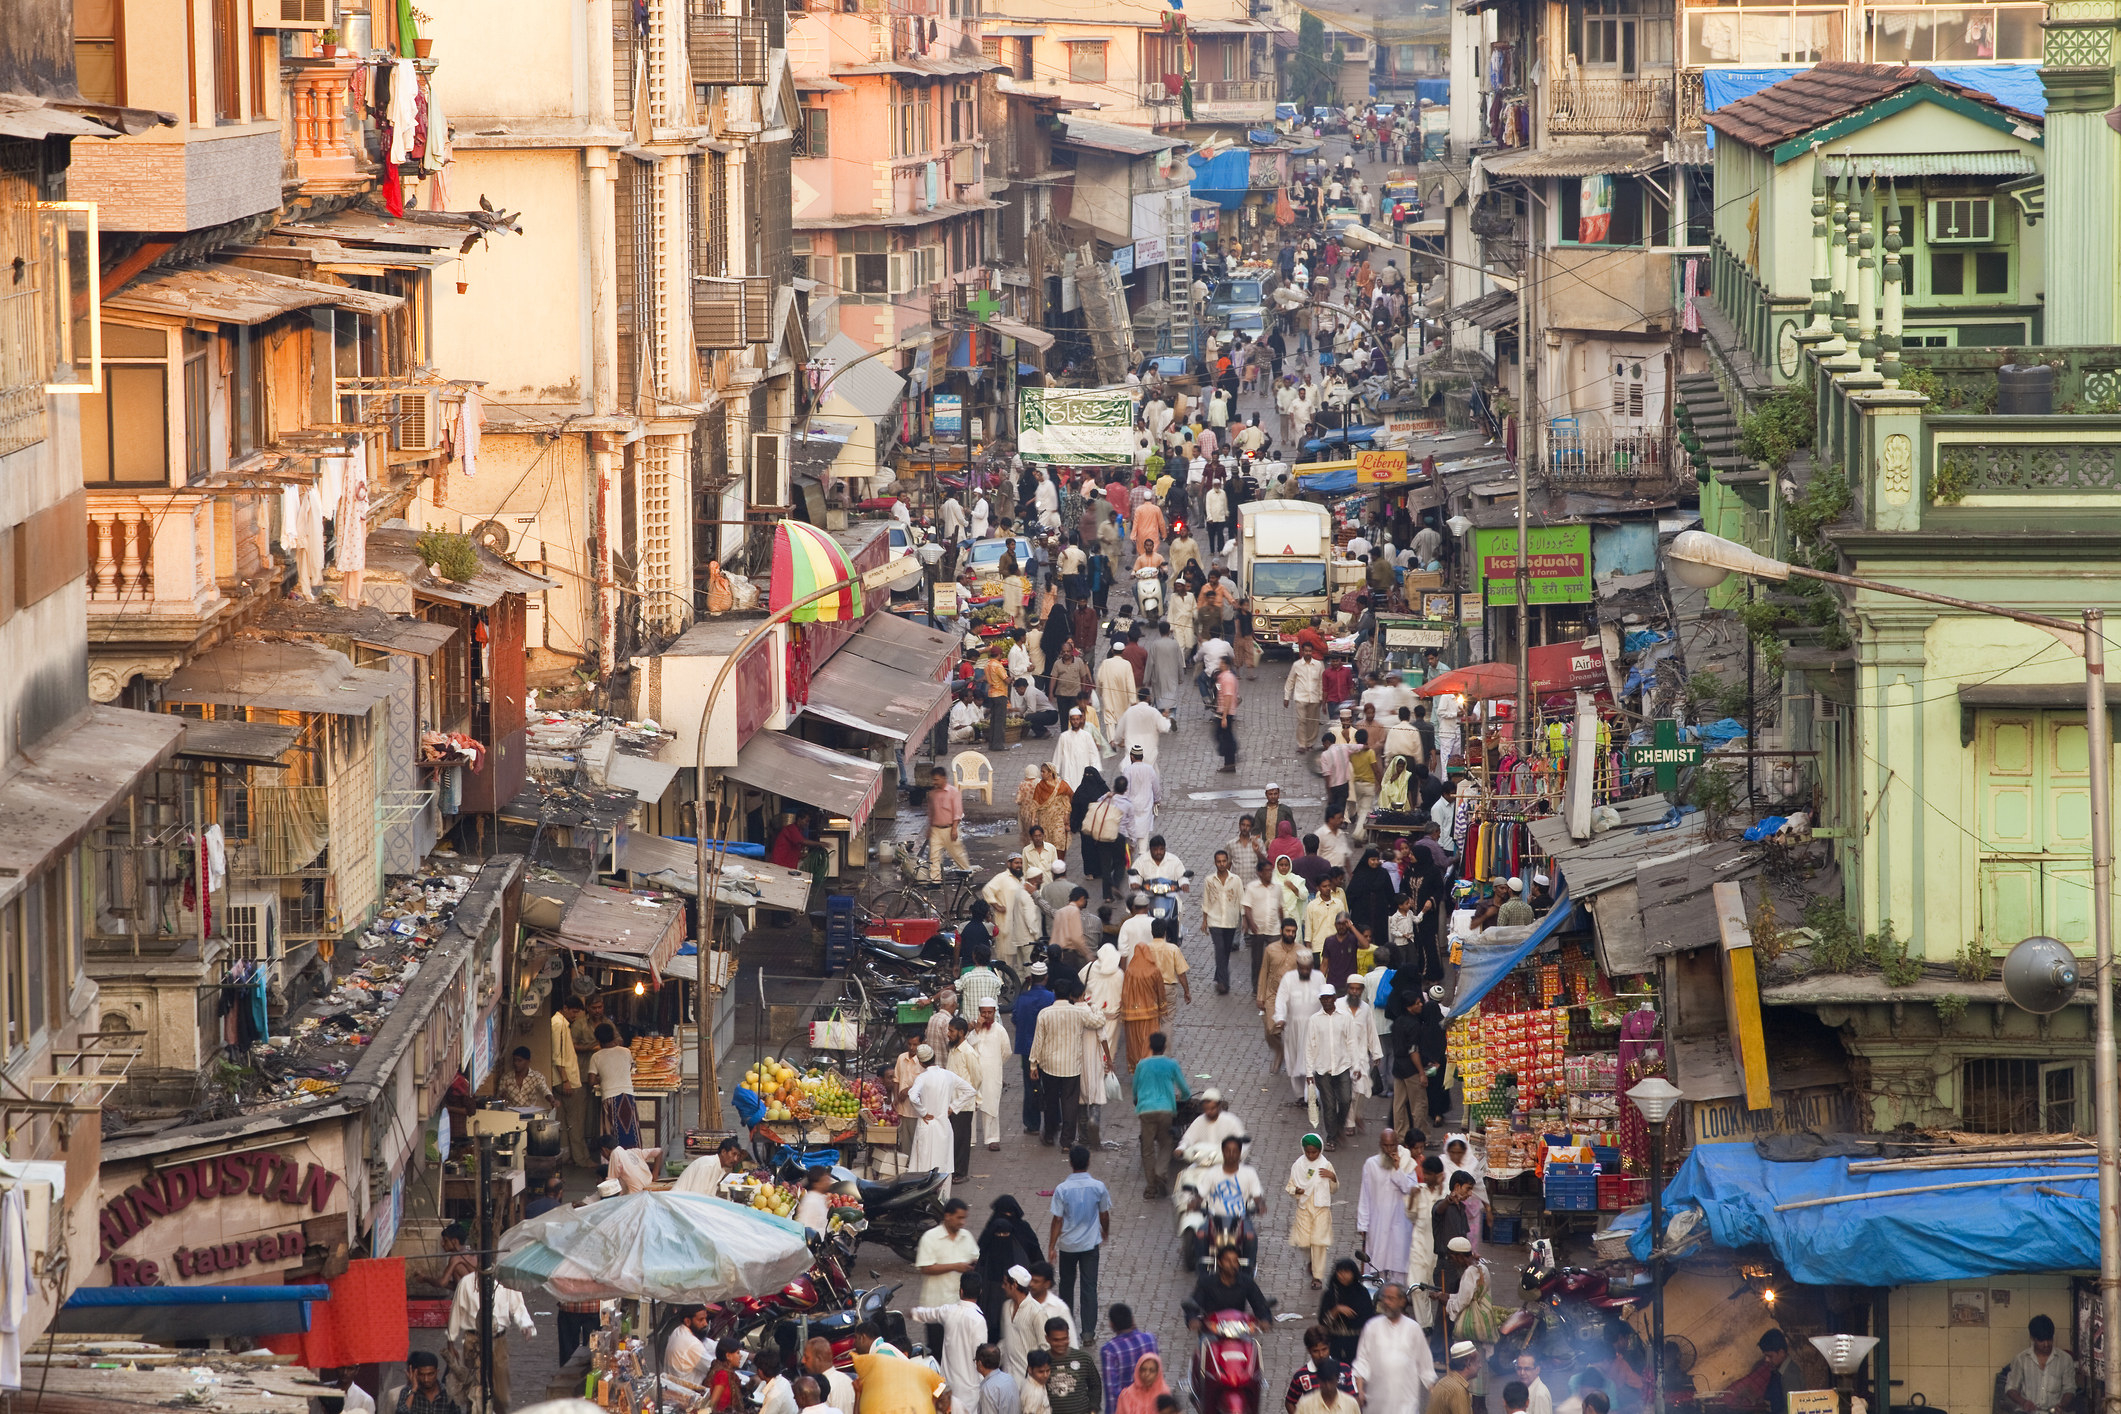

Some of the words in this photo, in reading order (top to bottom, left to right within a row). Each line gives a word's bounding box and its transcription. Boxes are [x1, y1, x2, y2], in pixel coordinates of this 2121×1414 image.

[1358, 454, 1405, 471] Liberty
[1490, 555, 1579, 569] kesodwala
[1574, 656, 1605, 670] Airtel
[1634, 748, 1696, 764] CHEMIST
[1300, 1375, 1310, 1389] 5
